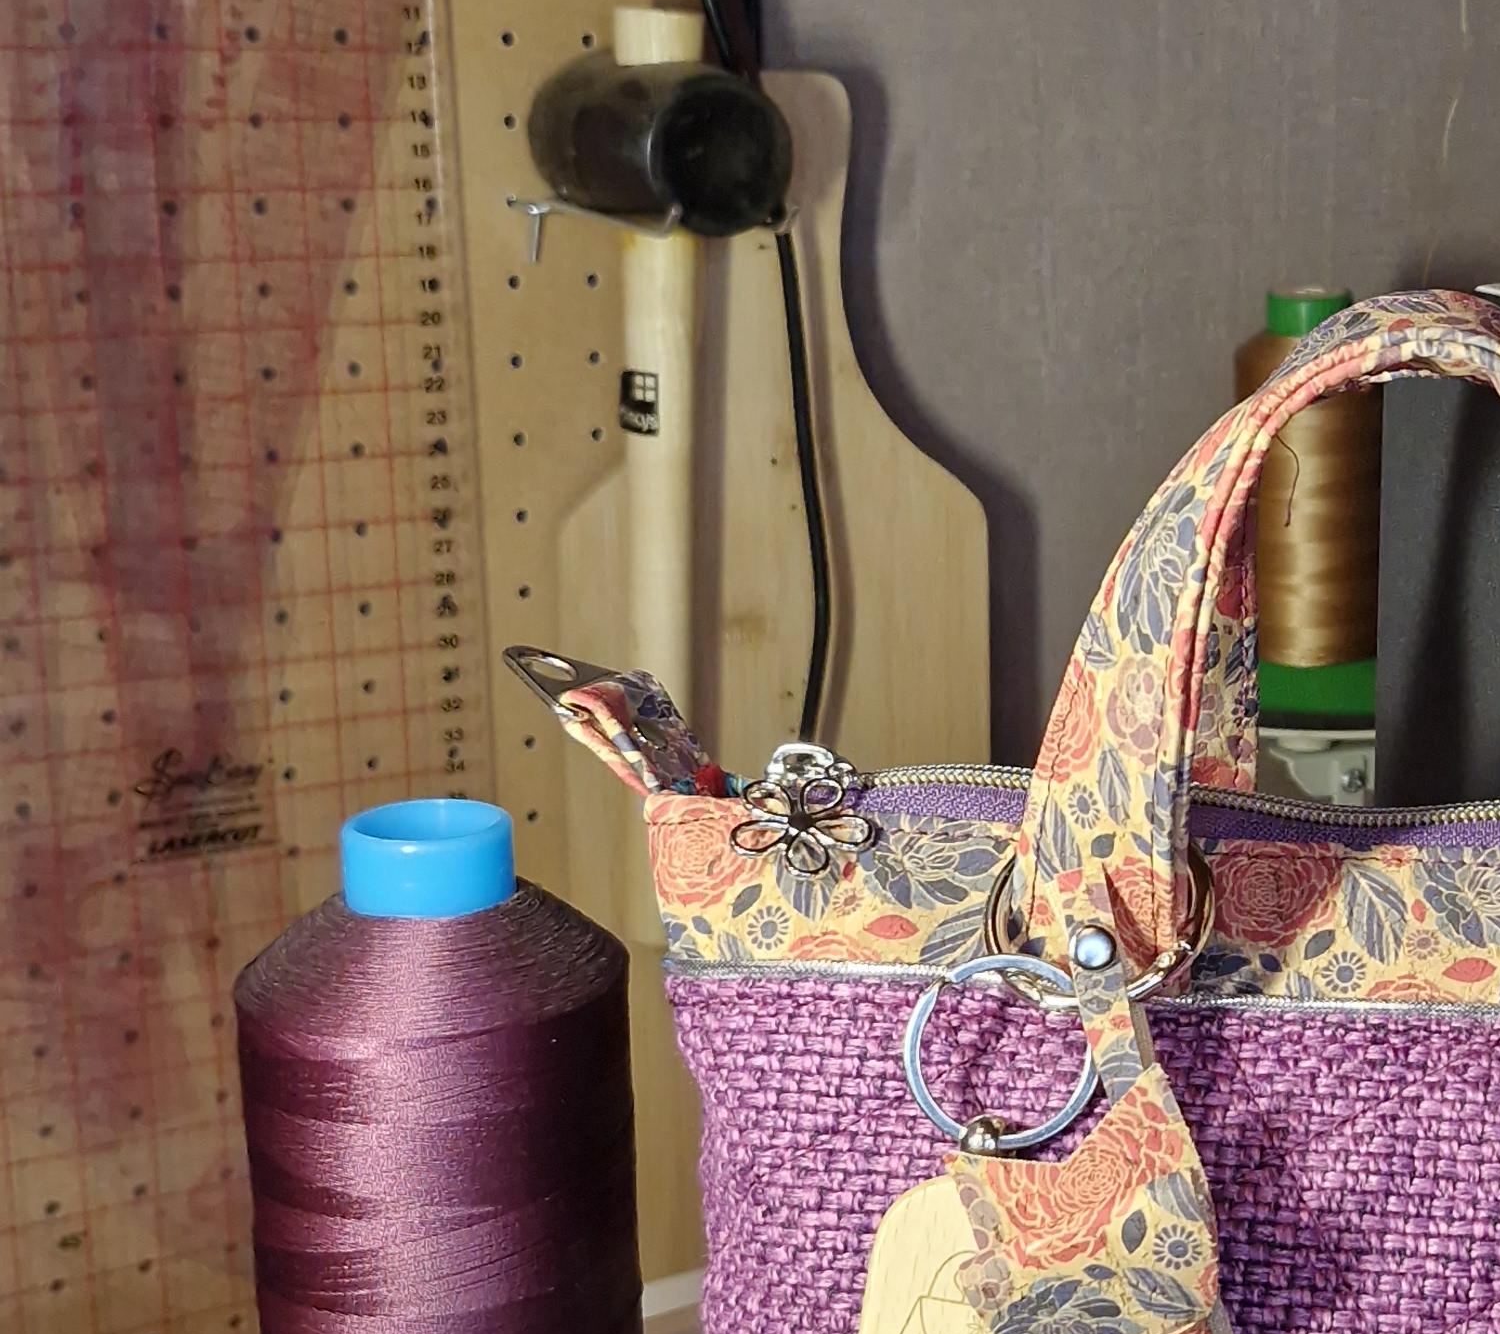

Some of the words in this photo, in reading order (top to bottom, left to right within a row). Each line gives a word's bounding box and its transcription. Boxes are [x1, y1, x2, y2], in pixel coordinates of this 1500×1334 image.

[402, 5, 420, 22] 11
[421, 310, 441, 327] 20
[422, 344, 441, 361] 21
[426, 409, 447, 426] 23
